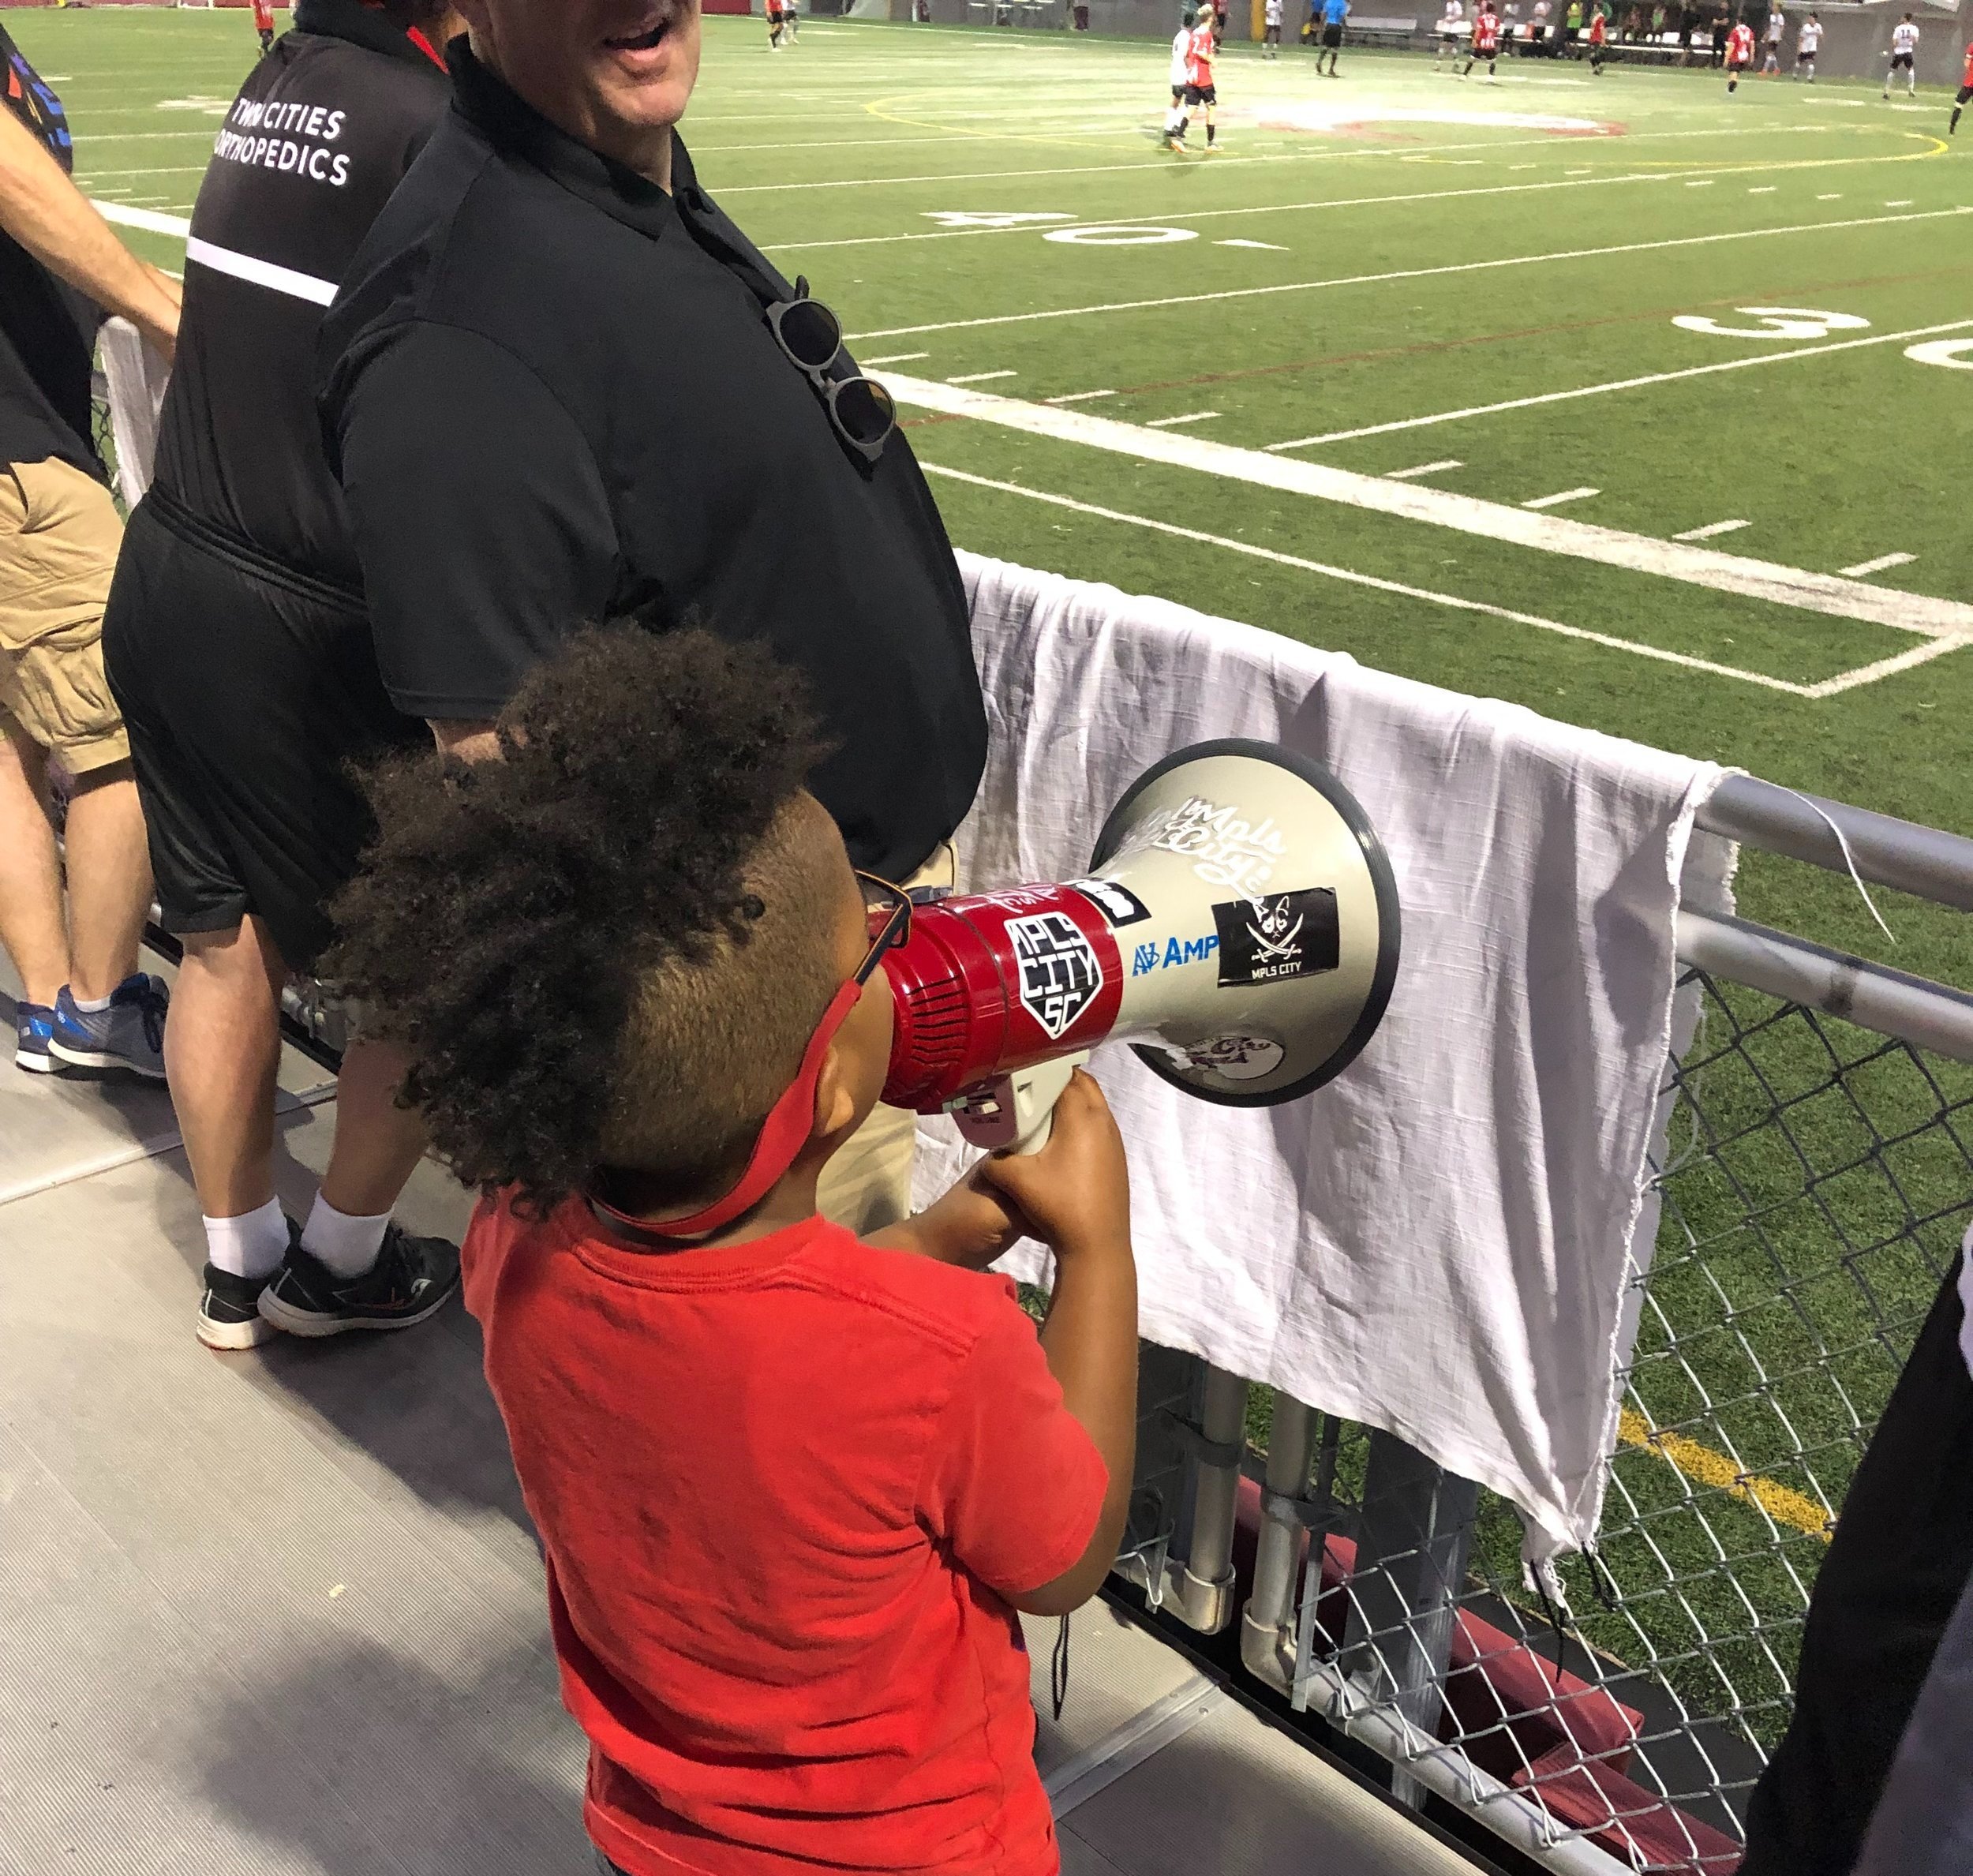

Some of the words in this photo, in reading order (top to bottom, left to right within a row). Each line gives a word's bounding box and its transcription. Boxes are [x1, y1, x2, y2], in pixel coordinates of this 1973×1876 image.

[264, 102, 346, 140] CITIES
[214, 128, 350, 186] ORTHOPEDICS
[1008, 914, 1089, 956] MPLS
[1021, 948, 1098, 998] CITY
[1251, 966, 1278, 979] MPLS
[1279, 960, 1302, 975] CITY
[1044, 992, 1082, 1035] SC
